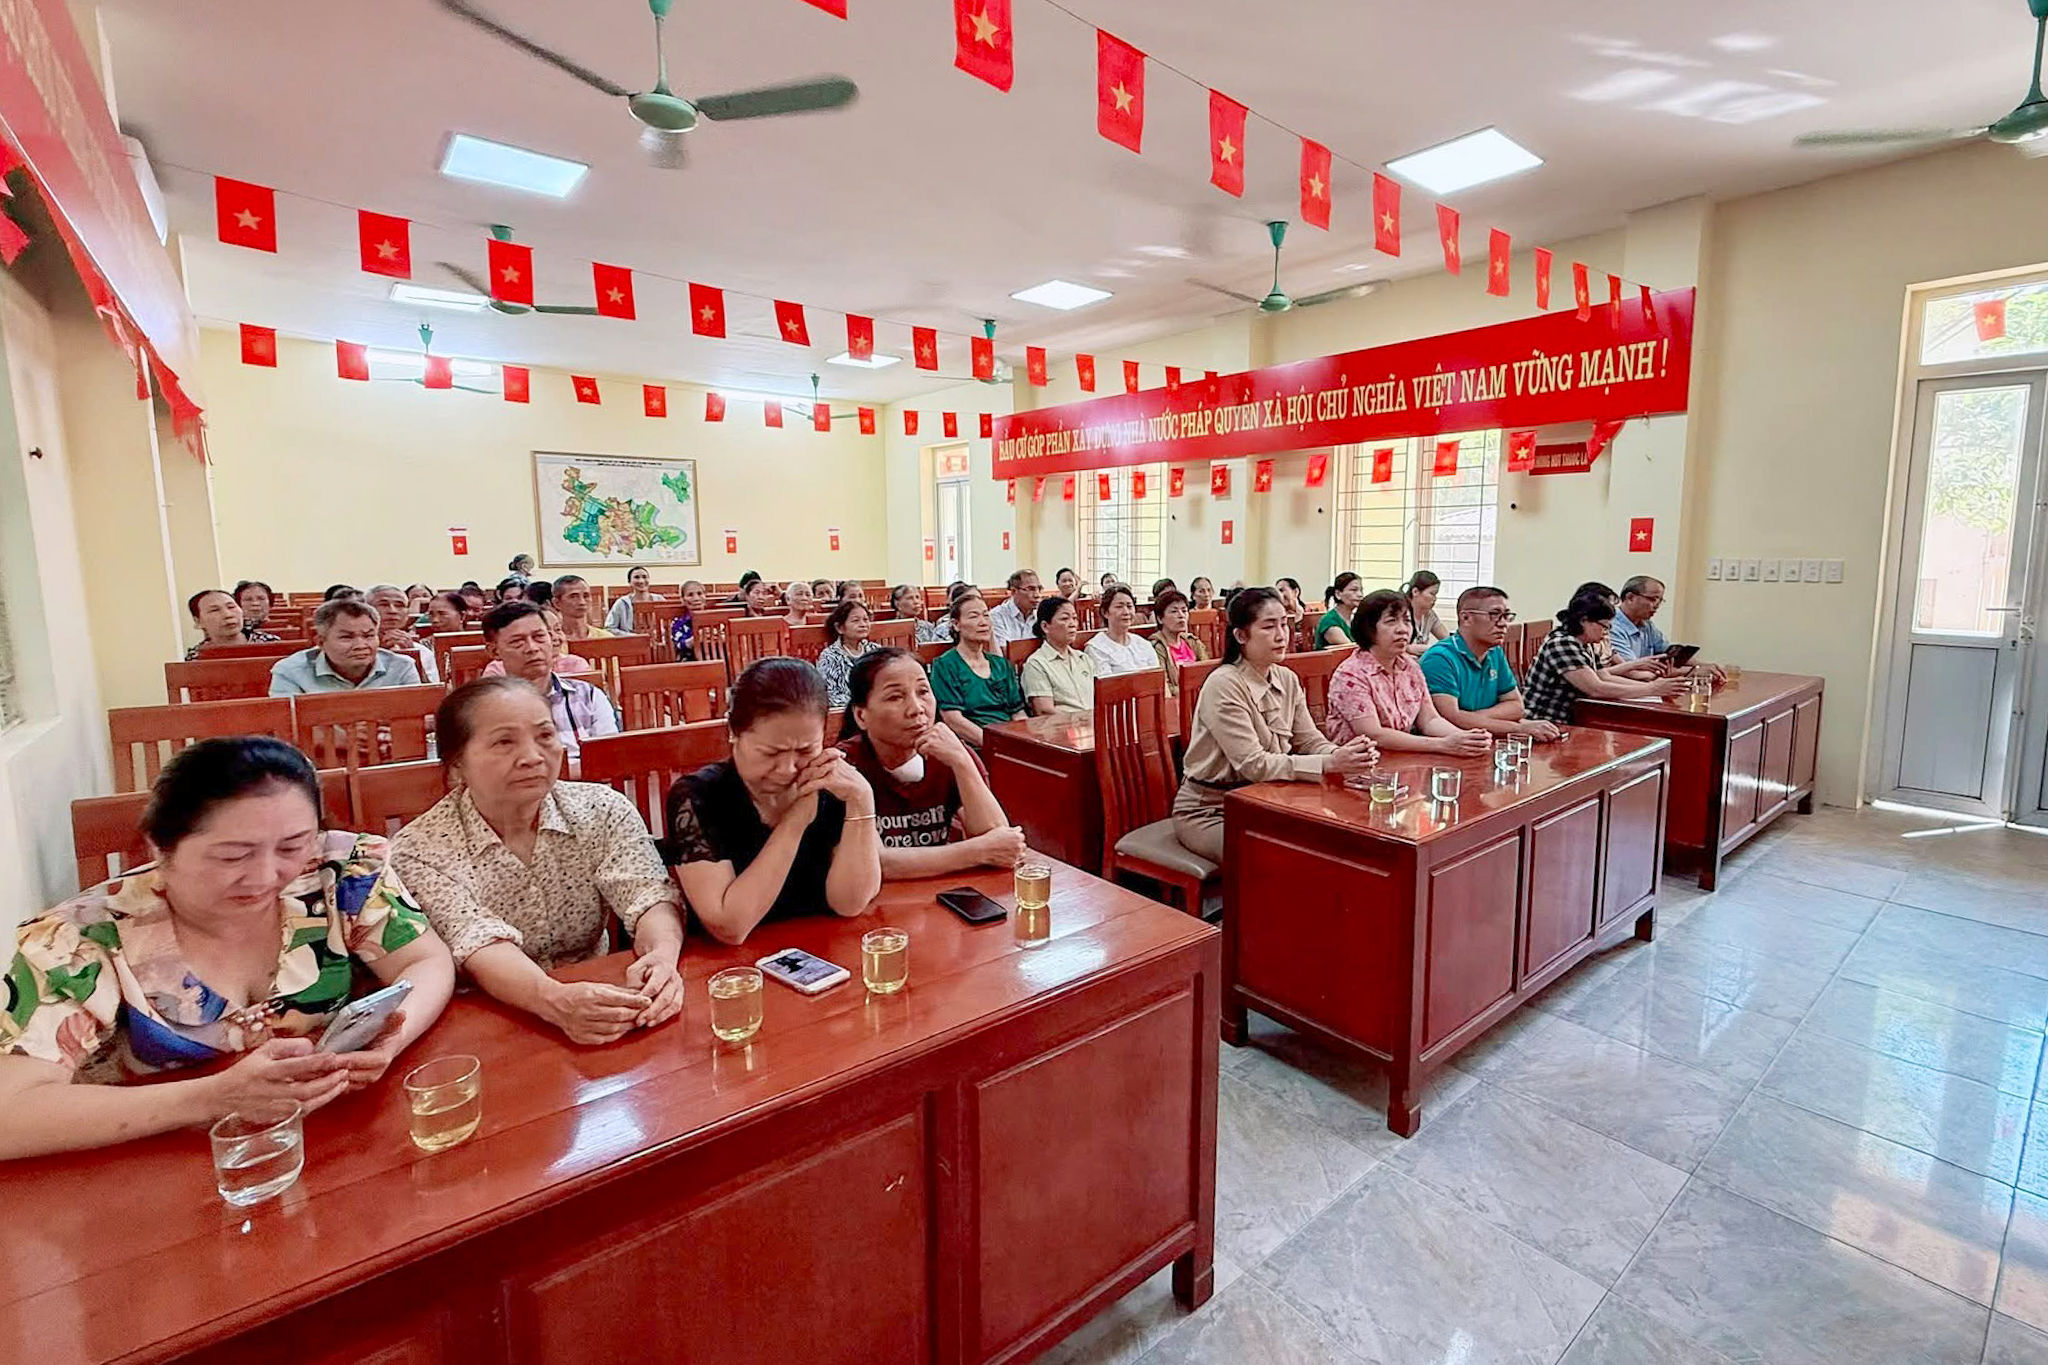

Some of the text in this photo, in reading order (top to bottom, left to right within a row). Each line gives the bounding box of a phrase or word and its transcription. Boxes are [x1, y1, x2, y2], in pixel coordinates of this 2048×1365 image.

[999, 428, 1014, 462] BẦU
[1016, 427, 1027, 459] CỬ
[1028, 428, 1045, 458] GÓP
[1046, 418, 1071, 456] PHẦN
[1072, 421, 1093, 452] XÂY
[1123, 412, 1146, 445] NHÀ
[1149, 406, 1178, 442] NƯỚC
[1180, 401, 1212, 438] PHÁP
[1214, 388, 1260, 435] QUYỀN
[1263, 391, 1283, 428] XÃ
[1286, 385, 1314, 431] HỘI
[1317, 374, 1349, 421] CHỦ
[1352, 373, 1407, 417] NGHĨA
[1412, 363, 1456, 416] VIỆT
[1459, 364, 1508, 403] NAM
[1513, 349, 1574, 396] VỮNG
[1578, 340, 1657, 395] MẠNH
[876, 805, 945, 834] yourself
